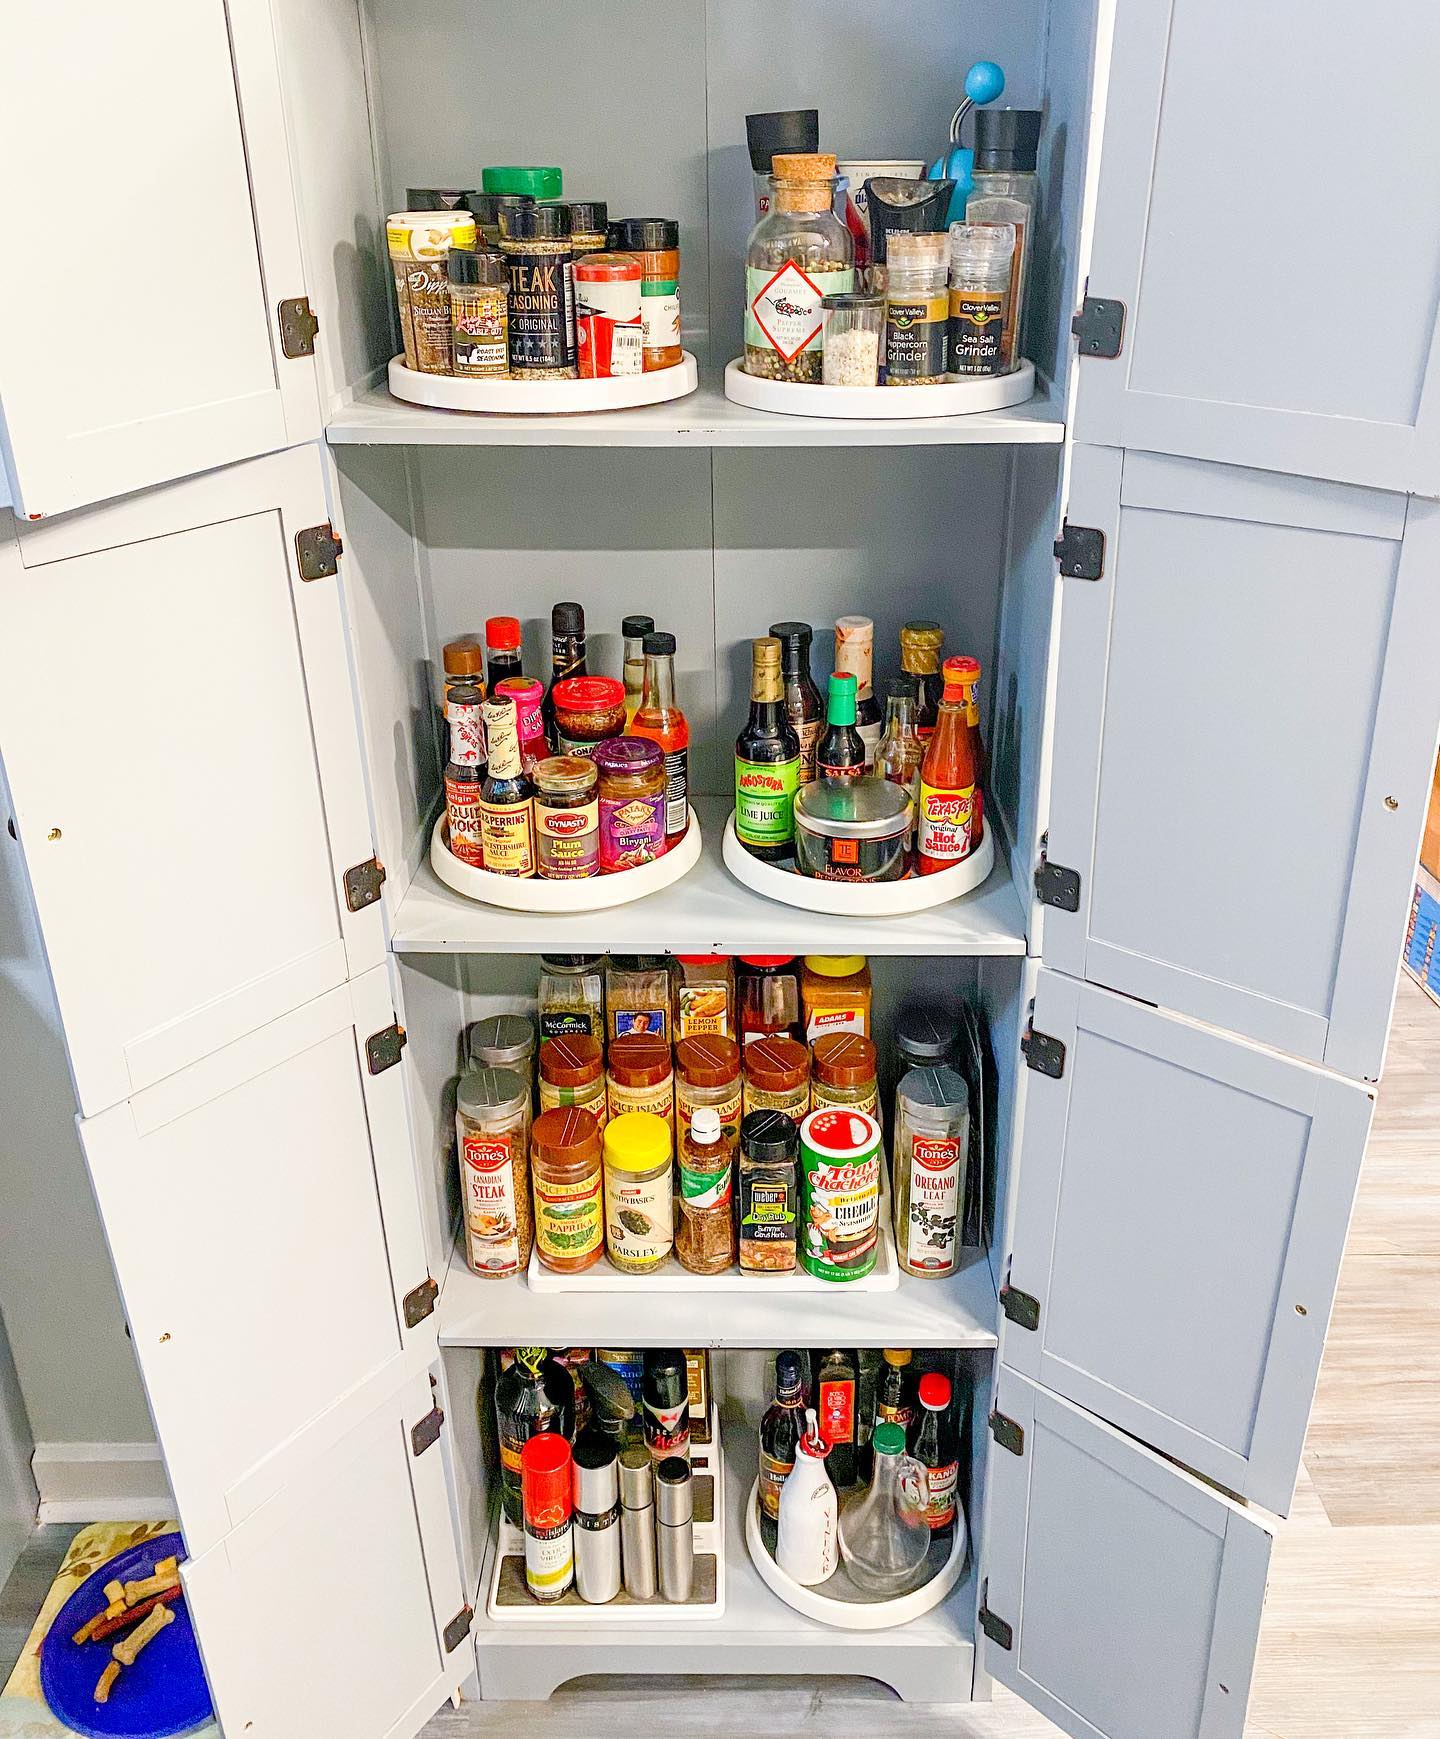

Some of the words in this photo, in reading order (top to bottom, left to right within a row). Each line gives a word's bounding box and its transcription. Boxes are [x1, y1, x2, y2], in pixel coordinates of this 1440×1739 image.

[408, 270, 449, 295] Dipp
[510, 266, 556, 292] TEAK
[961, 303, 982, 312] Clover
[519, 318, 558, 331] ORIGINAL
[893, 331, 914, 341] Black
[962, 334, 978, 344] Sea
[979, 334, 995, 344] Salt
[887, 349, 928, 362] Grinder
[955, 343, 998, 357] Grinder
[522, 705, 543, 726] DIPP
[740, 806, 759, 820] LIME
[760, 810, 784, 822] JUICE
[548, 818, 586, 828] DYNASTY
[929, 825, 958, 833] Original
[552, 839, 582, 849] Plum
[619, 835, 652, 848] Biryani
[932, 831, 956, 844] Hot
[925, 838, 961, 853] Sauce
[550, 848, 585, 859] Sauce
[825, 864, 862, 877] FLAVOR
[545, 1020, 588, 1030] McCormick
[817, 1013, 847, 1024] ADAMS
[473, 1174, 502, 1185] CANADIAN
[915, 1173, 955, 1190] OREGANO
[472, 1184, 506, 1199] STEAK
[754, 1191, 778, 1203] weber
[923, 1190, 946, 1200] LEAF
[549, 1218, 593, 1233] PAPRIKA
[612, 1243, 656, 1257] PARSLEY
